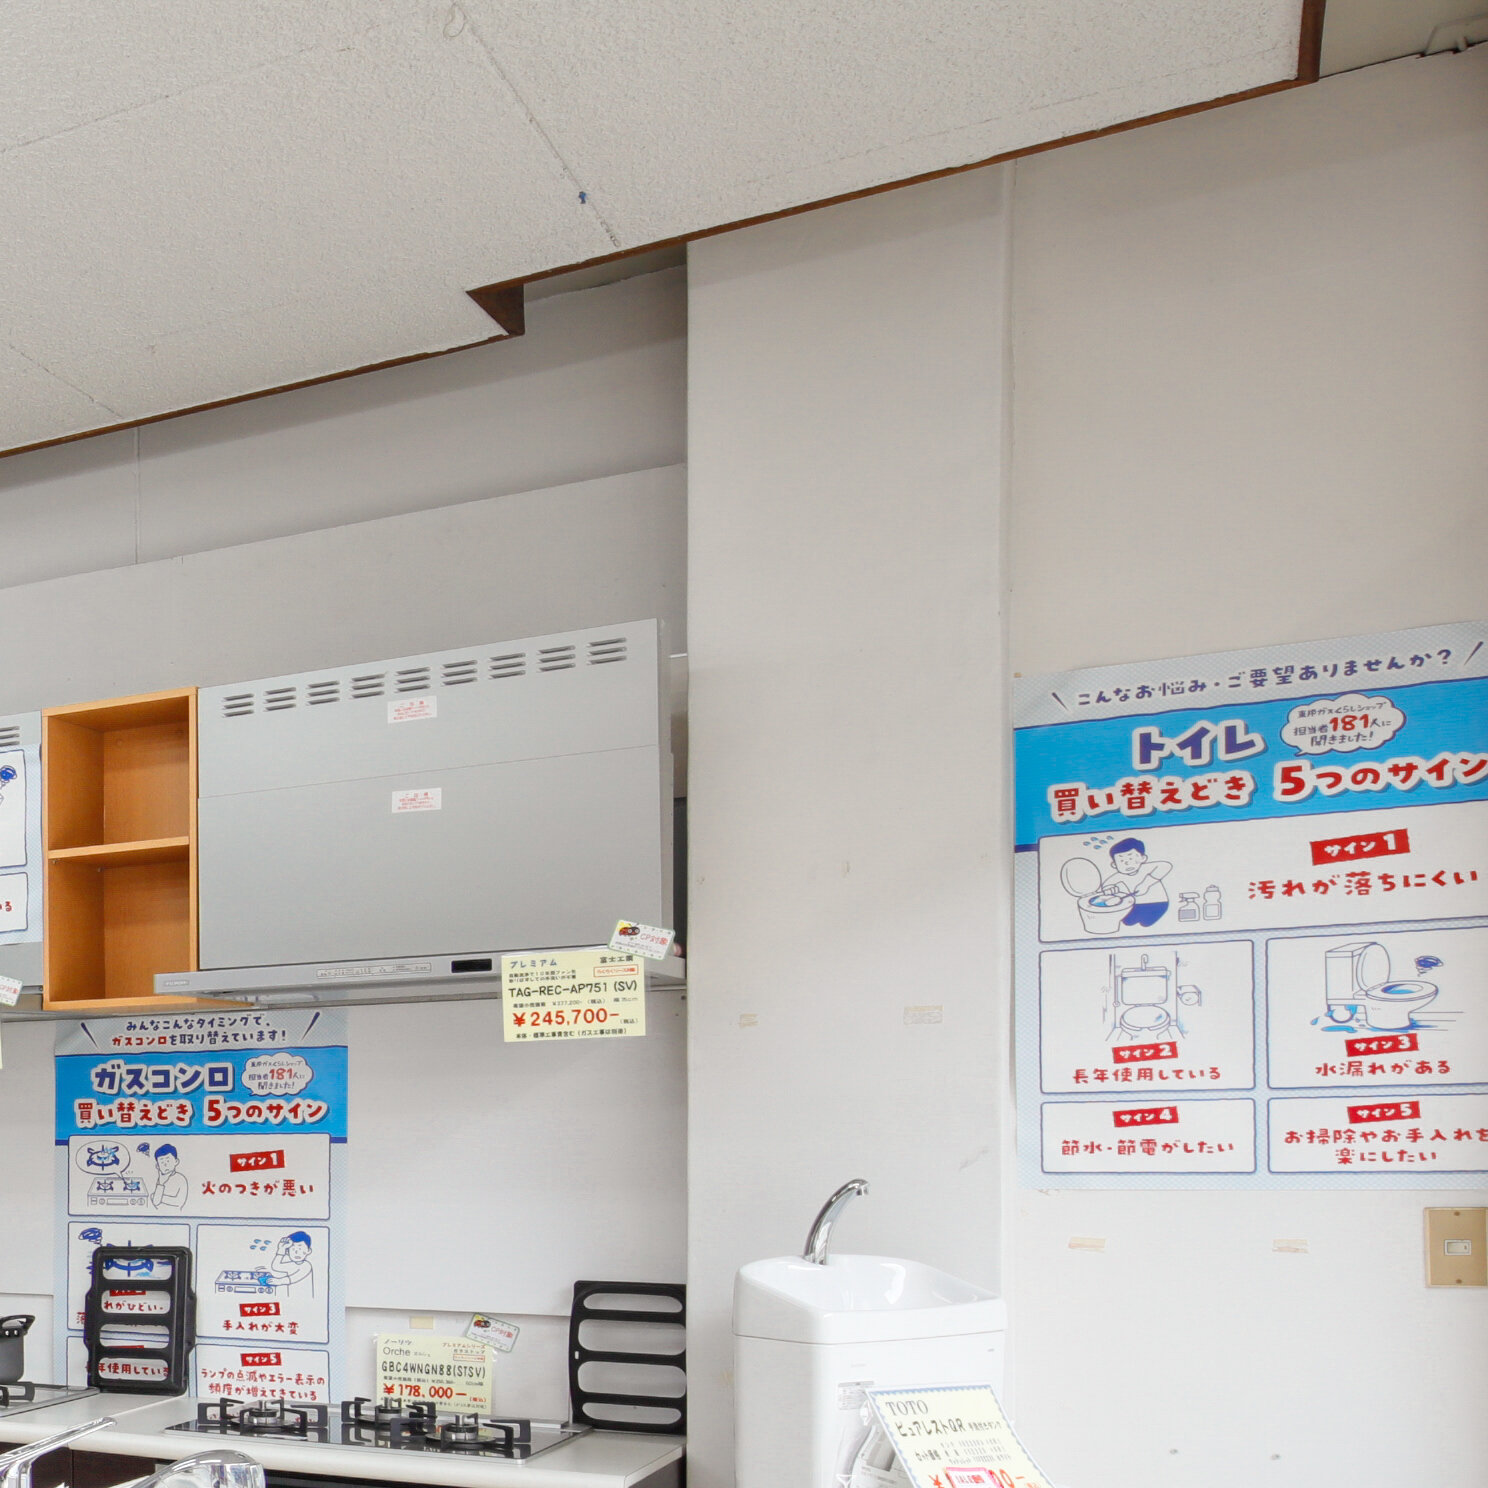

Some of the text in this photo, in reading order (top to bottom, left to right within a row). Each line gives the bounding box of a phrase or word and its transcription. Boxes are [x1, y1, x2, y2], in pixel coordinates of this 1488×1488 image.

[1077, 648, 1453, 706] こんなお悩み・ご要望ありませんか?
[1293, 714, 1391, 736] 担当者181人に
[1138, 725, 1257, 764] トイレ
[1311, 732, 1373, 746] 聞きました!
[1054, 757, 1488, 815] 買い替えどき 5つのサイン
[1248, 870, 1479, 902] 汚れが落ちにくい
[510, 959, 557, 969] プレミアム
[509, 982, 607, 998] TAG-REC-AP751
[126, 1015, 271, 1031] みんなこんなタイミングで、
[513, 1008, 619, 1027] ¥245,700-
[112, 1029, 286, 1047] ガスコンロを取り替えています!
[95, 1063, 229, 1090] ガスコンロ
[1072, 1065, 1221, 1083] 長年使用している
[1316, 1059, 1451, 1079] 水漏れがある
[77, 1099, 323, 1124] 買い替えどき 5つのサイン
[1062, 1139, 1235, 1157] 節水・節電がしたい
[1336, 1148, 1437, 1166] 楽にしたい
[201, 1179, 313, 1197] 火のつきが悪い
[223, 1319, 299, 1335] 手入れが大変
[383, 1347, 410, 1356] Orche
[200, 1368, 325, 1385] ランプの点滅やエラー表示の
[208, 1383, 317, 1400] 頻度が増えてきている
[383, 1383, 467, 1399] ¥178,000-
[886, 1400, 928, 1416] TOTO
